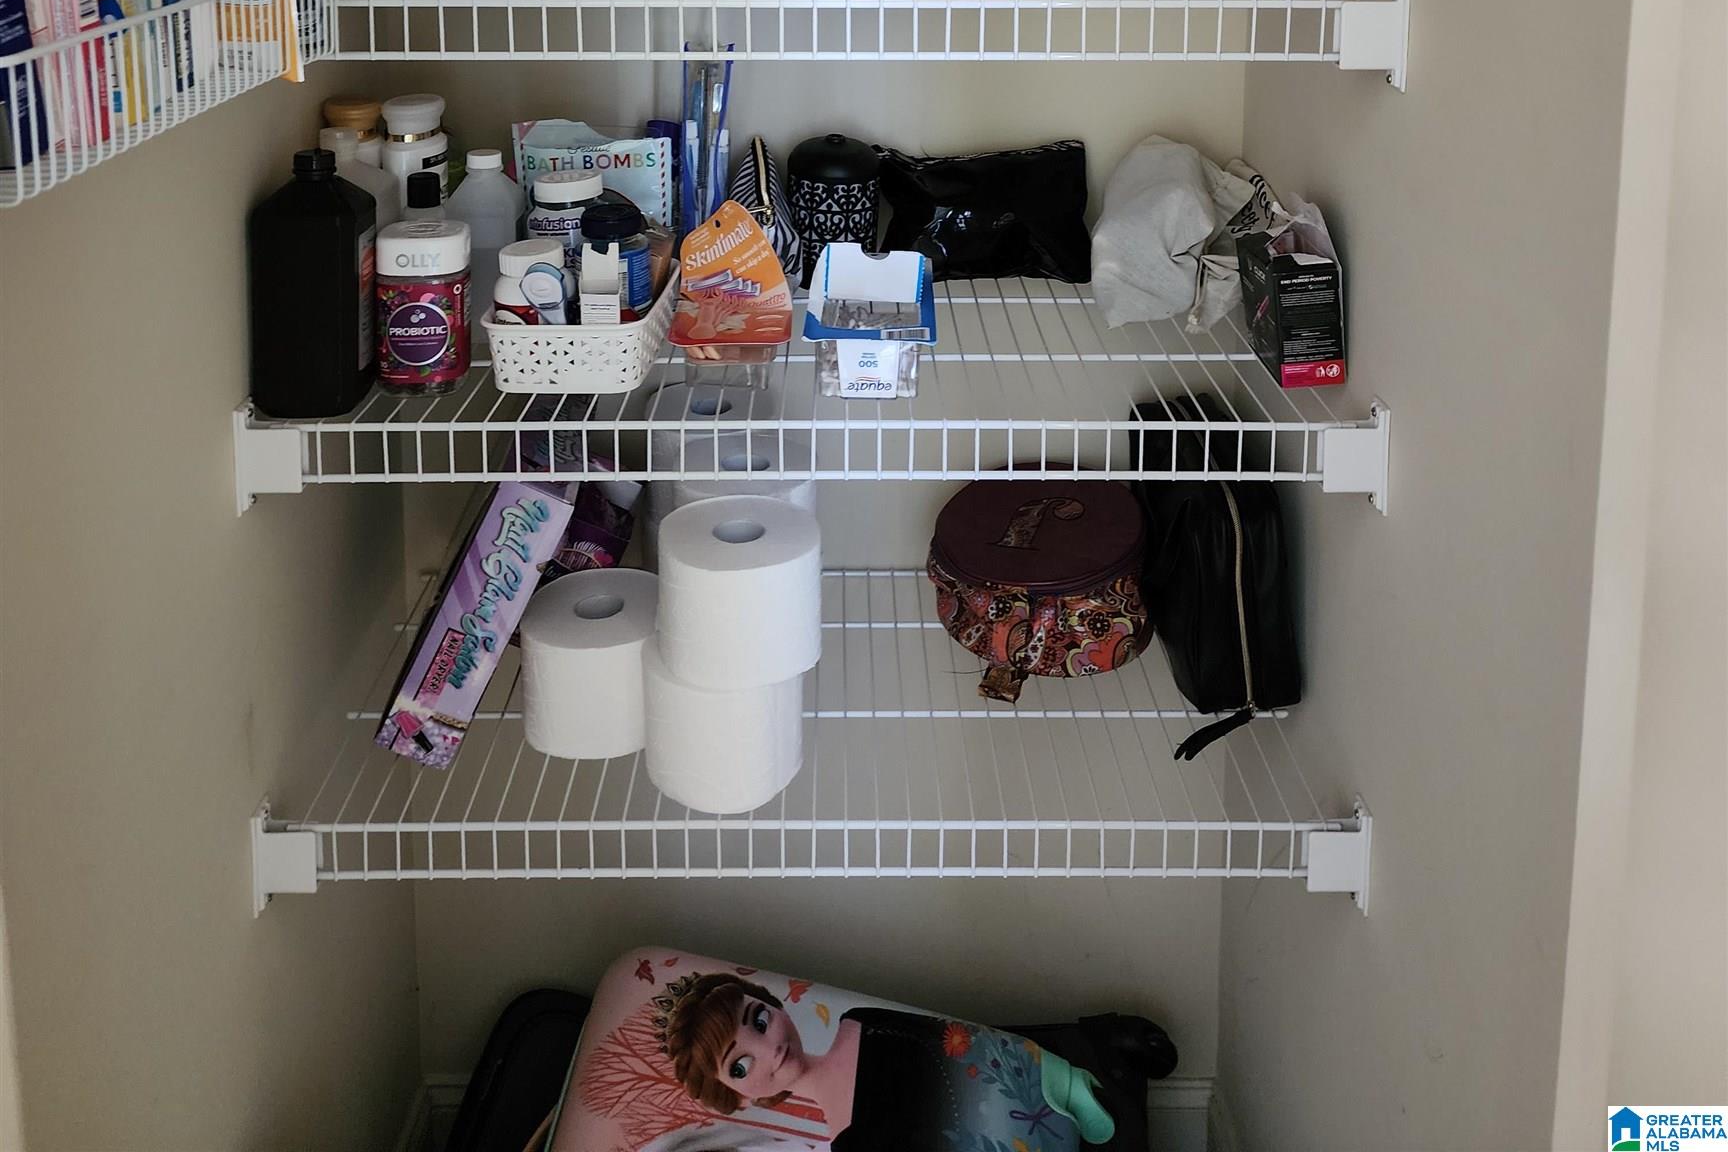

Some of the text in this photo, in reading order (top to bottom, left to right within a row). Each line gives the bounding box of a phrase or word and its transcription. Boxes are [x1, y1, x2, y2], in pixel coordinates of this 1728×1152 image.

[526, 152, 657, 171] BATH BOMBS
[685, 220, 754, 271] Skintimate
[395, 253, 441, 269] OLLY
[389, 325, 449, 336] PROBIOTIC
[858, 360, 879, 368] 500
[847, 379, 893, 392] equate
[491, 498, 550, 563] Nail
[480, 549, 524, 624] Glam
[439, 635, 460, 667] NAIL
